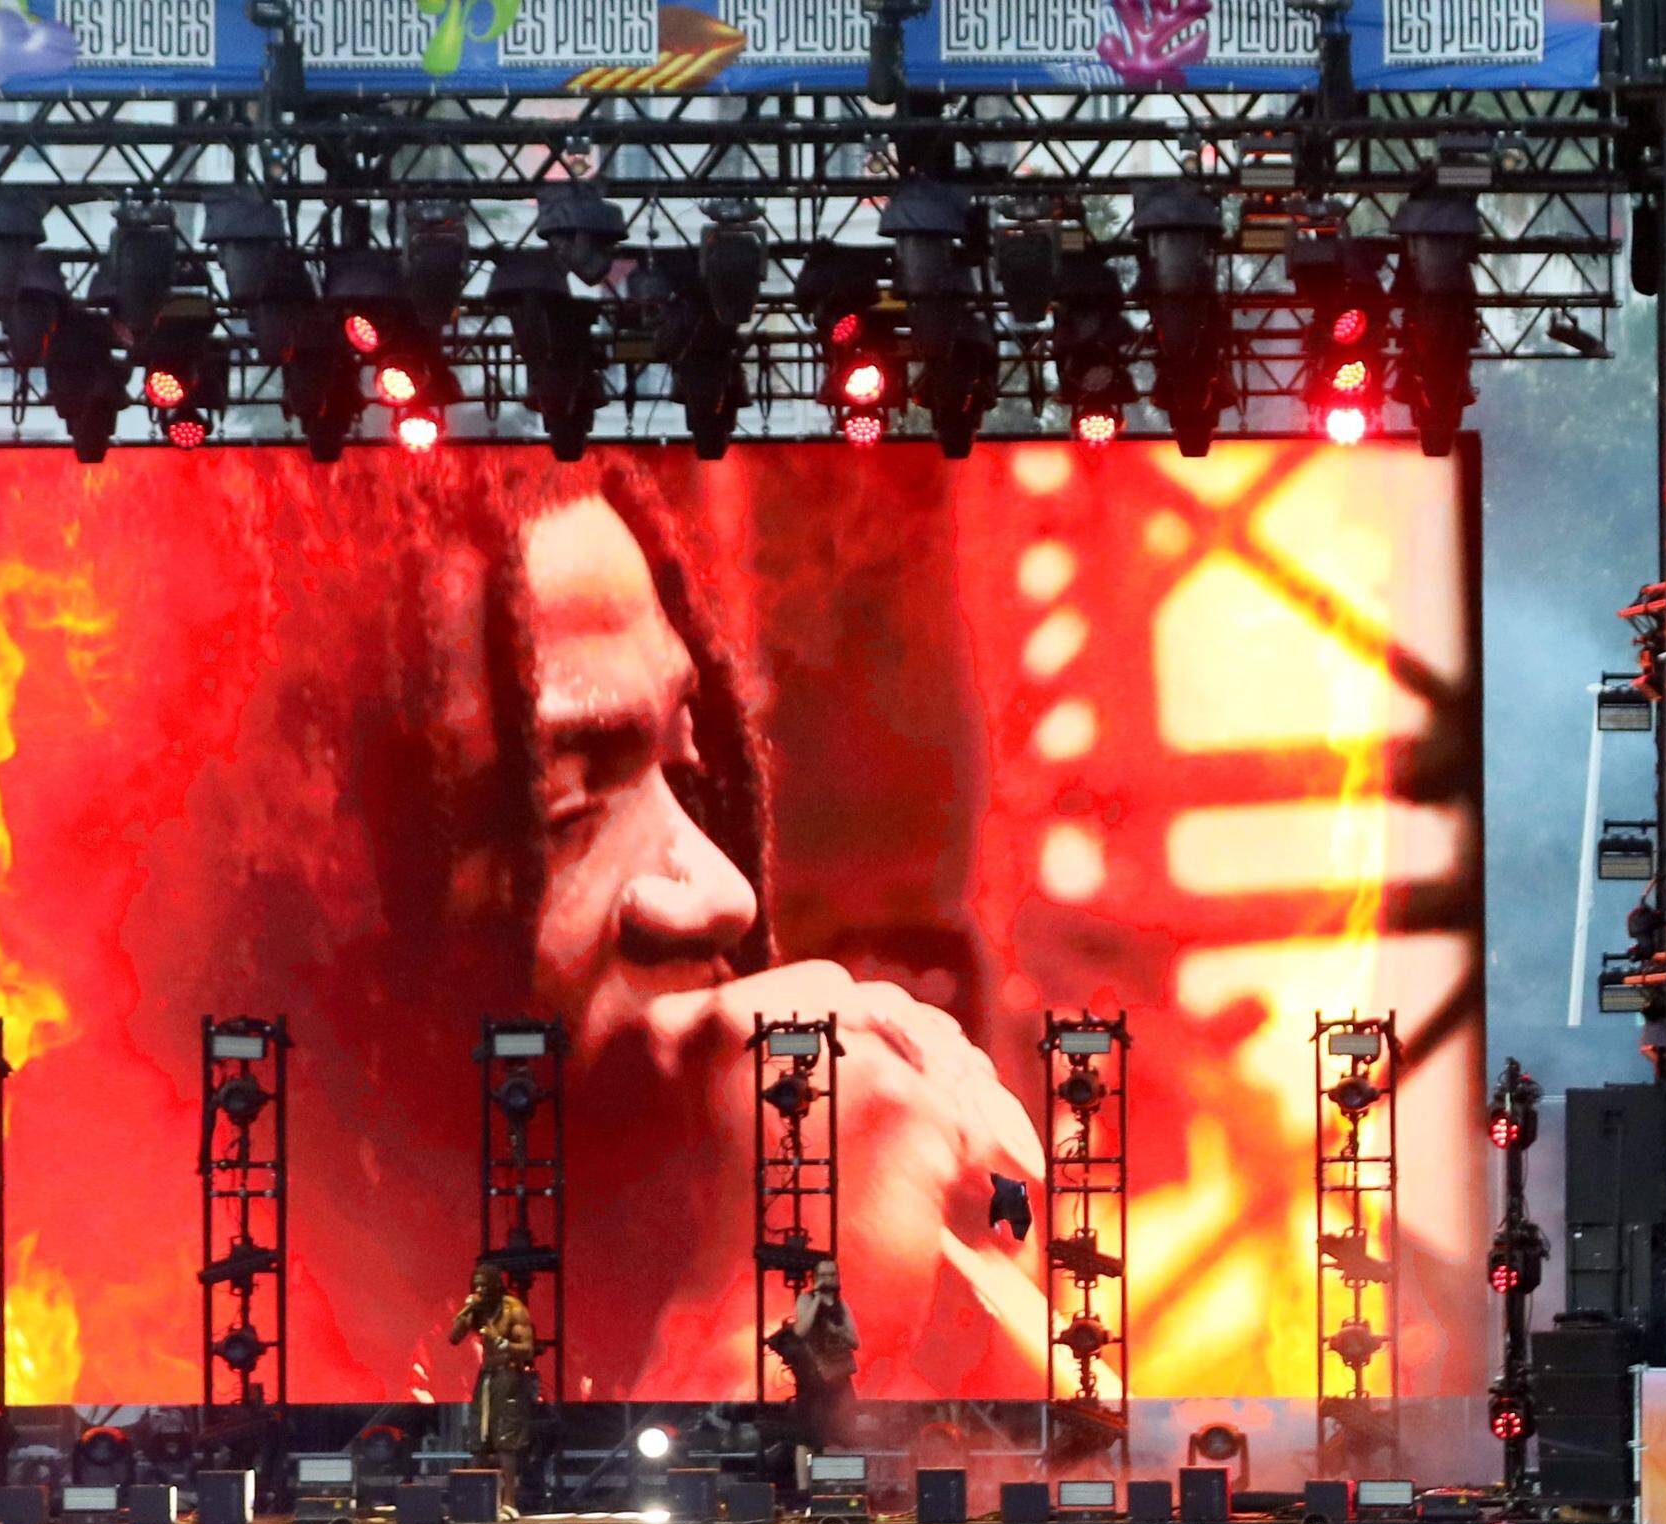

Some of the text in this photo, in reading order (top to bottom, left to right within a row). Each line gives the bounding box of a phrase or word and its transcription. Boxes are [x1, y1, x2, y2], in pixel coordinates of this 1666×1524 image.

[112, 0, 210, 57] PLAGES
[555, 0, 653, 55] PLAGES
[947, 0, 988, 51] LES
[998, 0, 1095, 51] PLAGES
[1389, 0, 1538, 53] LES PLAGES
